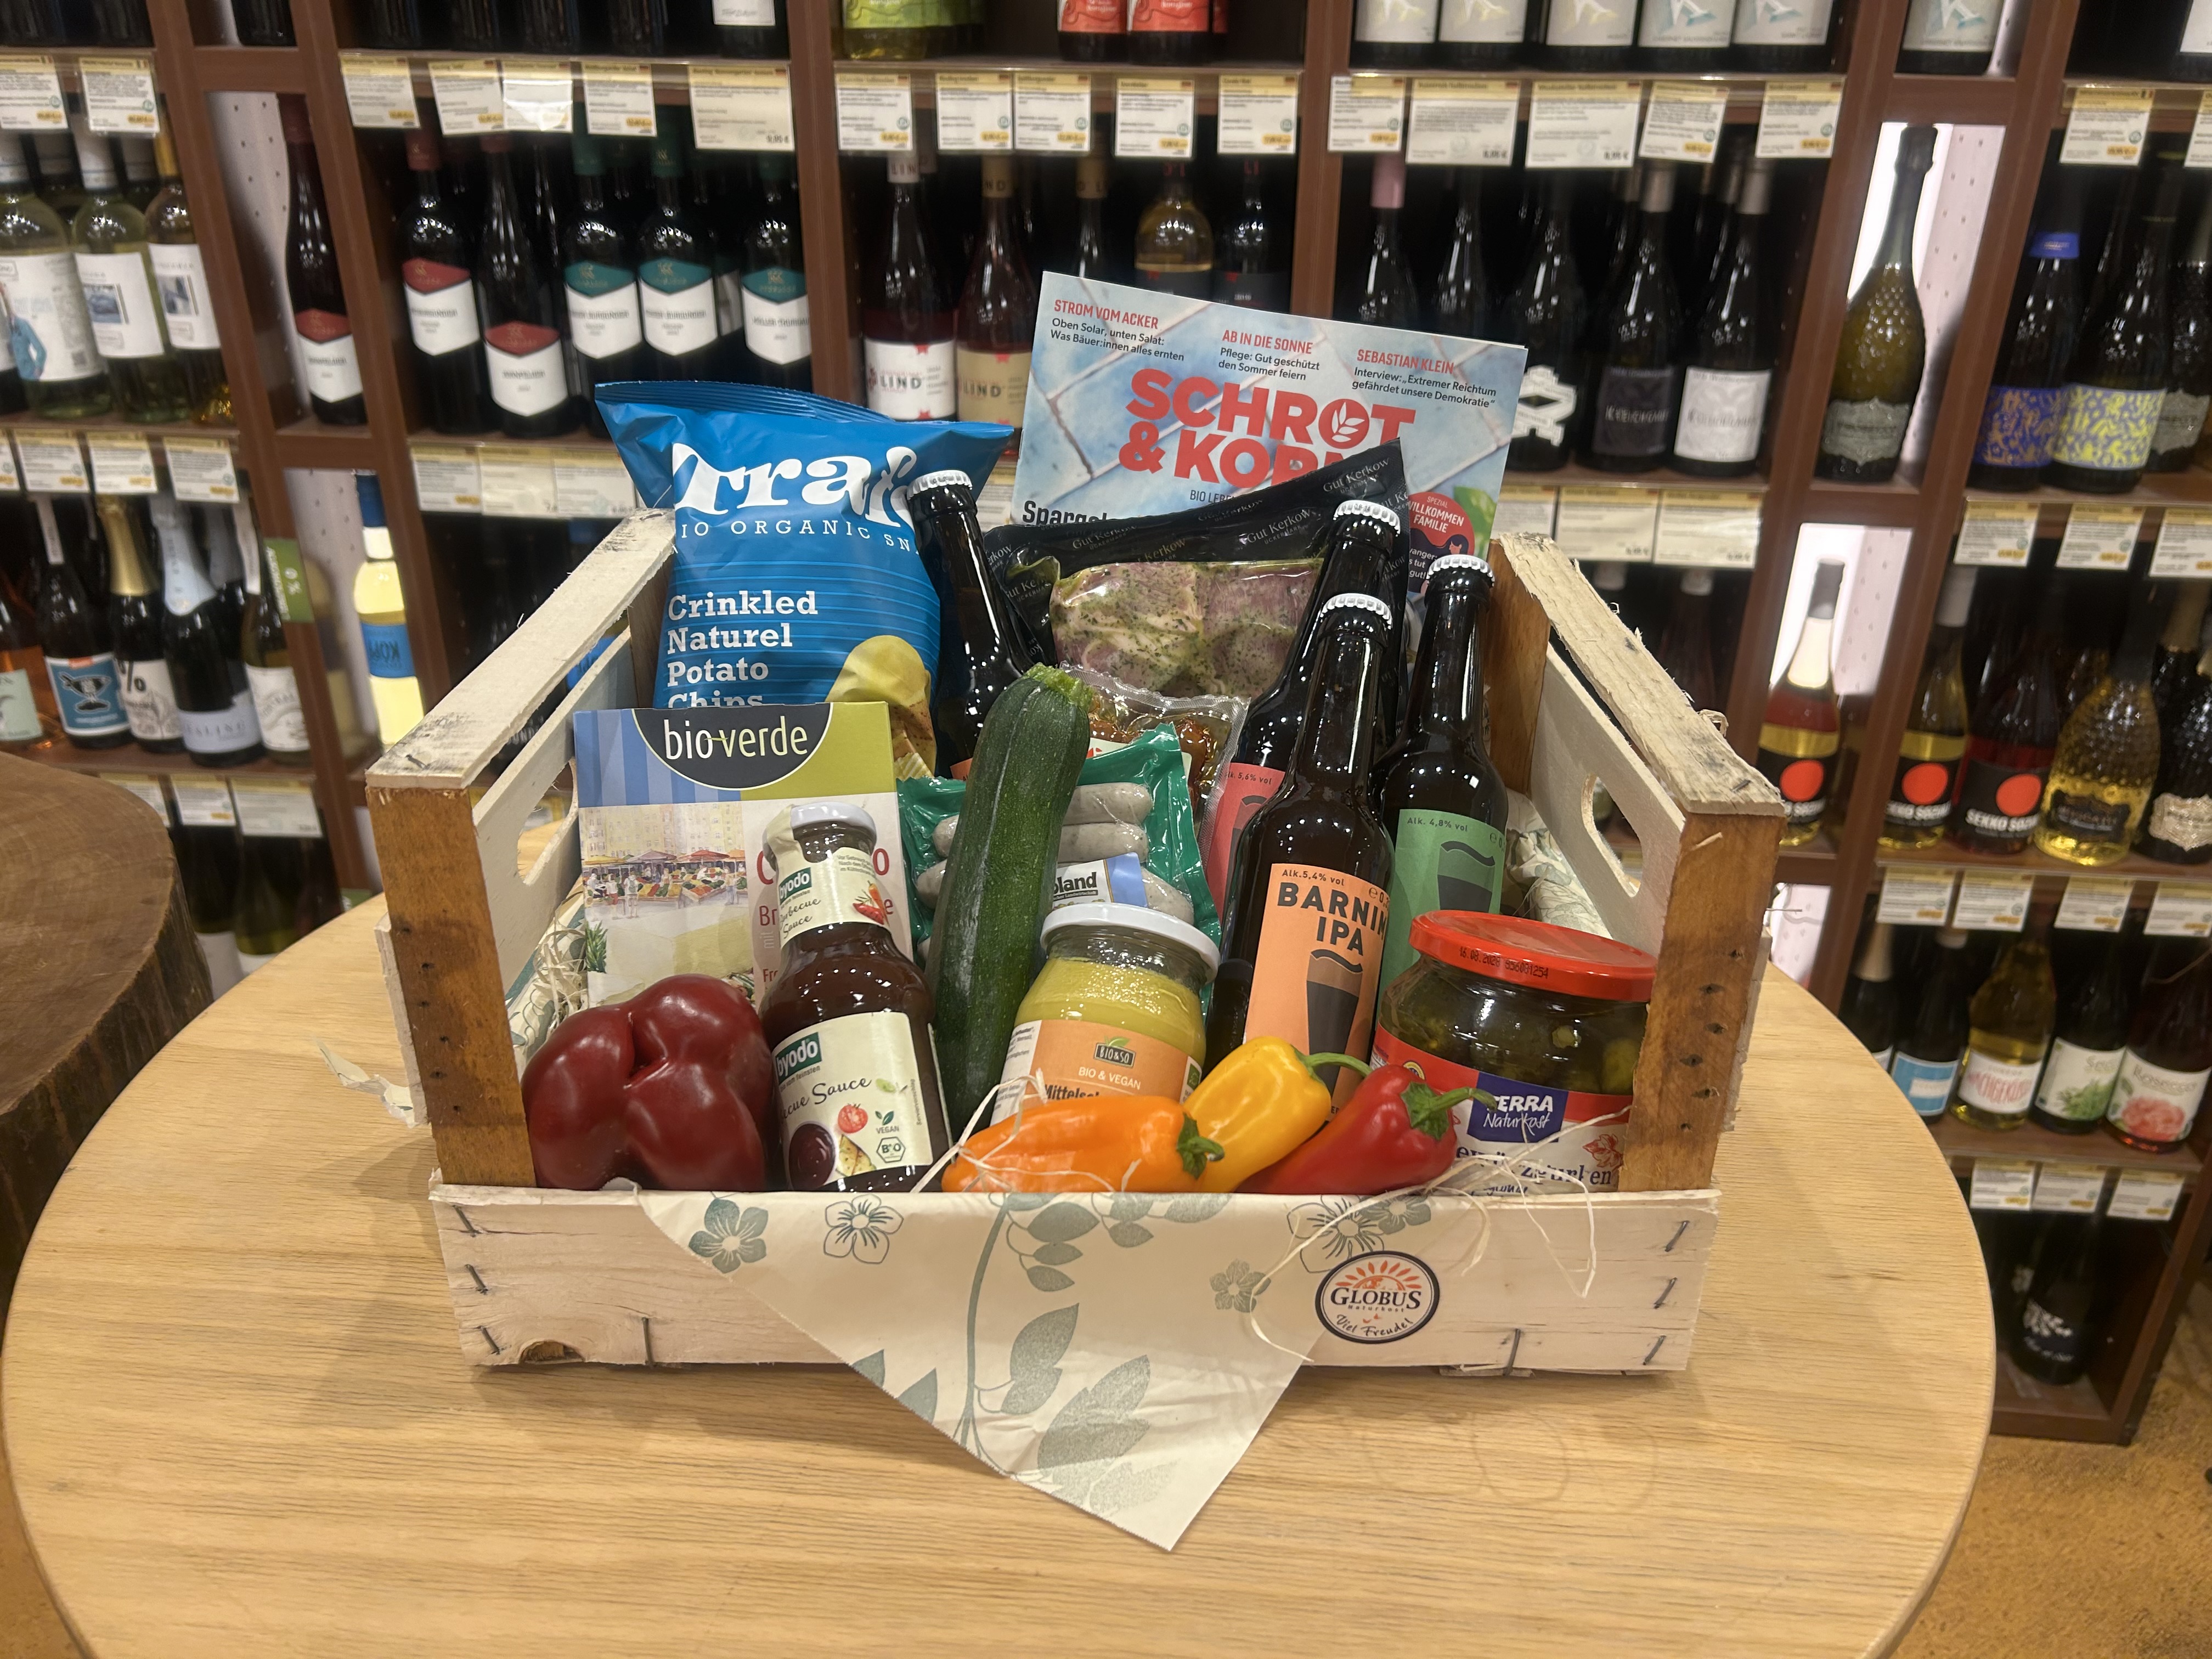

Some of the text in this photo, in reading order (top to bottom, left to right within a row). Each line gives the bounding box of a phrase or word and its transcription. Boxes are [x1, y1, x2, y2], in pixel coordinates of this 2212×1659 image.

[1054, 299, 1159, 329] STROM VOM ACKER
[1052, 318, 1165, 346] Oben Solar, unten Salat:
[1222, 330, 1313, 355] AB IN DIE SONNE
[1051, 329, 1184, 362] Was Bäuer:innen alles ernten
[1218, 359, 1307, 381] den Sommer feiern
[1220, 347, 1321, 372] Pflege: Gut geschützt
[1357, 348, 1454, 375] SEBASTIAN KLEIN
[1351, 380, 1400, 396] gefährdet
[1401, 386, 1433, 399] unsere
[1452, 381, 1497, 397] Reichtum
[1125, 368, 1417, 450] SCHROT
[1118, 419, 1166, 475] &
[672, 442, 916, 528] Traf
[1323, 456, 1391, 493] Gut Kerkow
[1189, 489, 1206, 502] BIO
[1426, 495, 1448, 509] SPEZIAL
[1246, 508, 1311, 544] Gut Kerkow
[1413, 514, 1449, 534] FAMILIE
[680, 519, 919, 555] IO ORGANIC SN
[1072, 535, 1093, 550] Gut
[987, 544, 1012, 566] erkow
[1414, 559, 1426, 569] tut
[668, 589, 819, 620] Crinkled
[667, 622, 793, 655] Naturel
[667, 658, 769, 687] Potato
[1238, 772, 1256, 781] 5,6%
[1259, 777, 1272, 785] vol
[1407, 817, 1468, 832] Alk. 4,8% vol
[779, 871, 810, 900] byodo
[1053, 871, 1097, 895] oland
[1329, 876, 1345, 887] vol
[782, 915, 813, 939] Sauce
[1316, 916, 1364, 956] IPA
[776, 1039, 819, 1077] byodo
[1099, 1045, 1131, 1064] BIO&SO
[796, 1065, 821, 1080] feinsten
[1079, 1066, 1141, 1090] BIO & VEGAN
[812, 1077, 872, 1105] Sauce
[1045, 1084, 1100, 1101] Mittels
[1486, 1094, 1554, 1113] ERRA
[876, 1125, 900, 1135] VEGAN
[1330, 1286, 1422, 1310] GLOBUS
[1336, 1314, 1414, 1337] Viel Freude!
